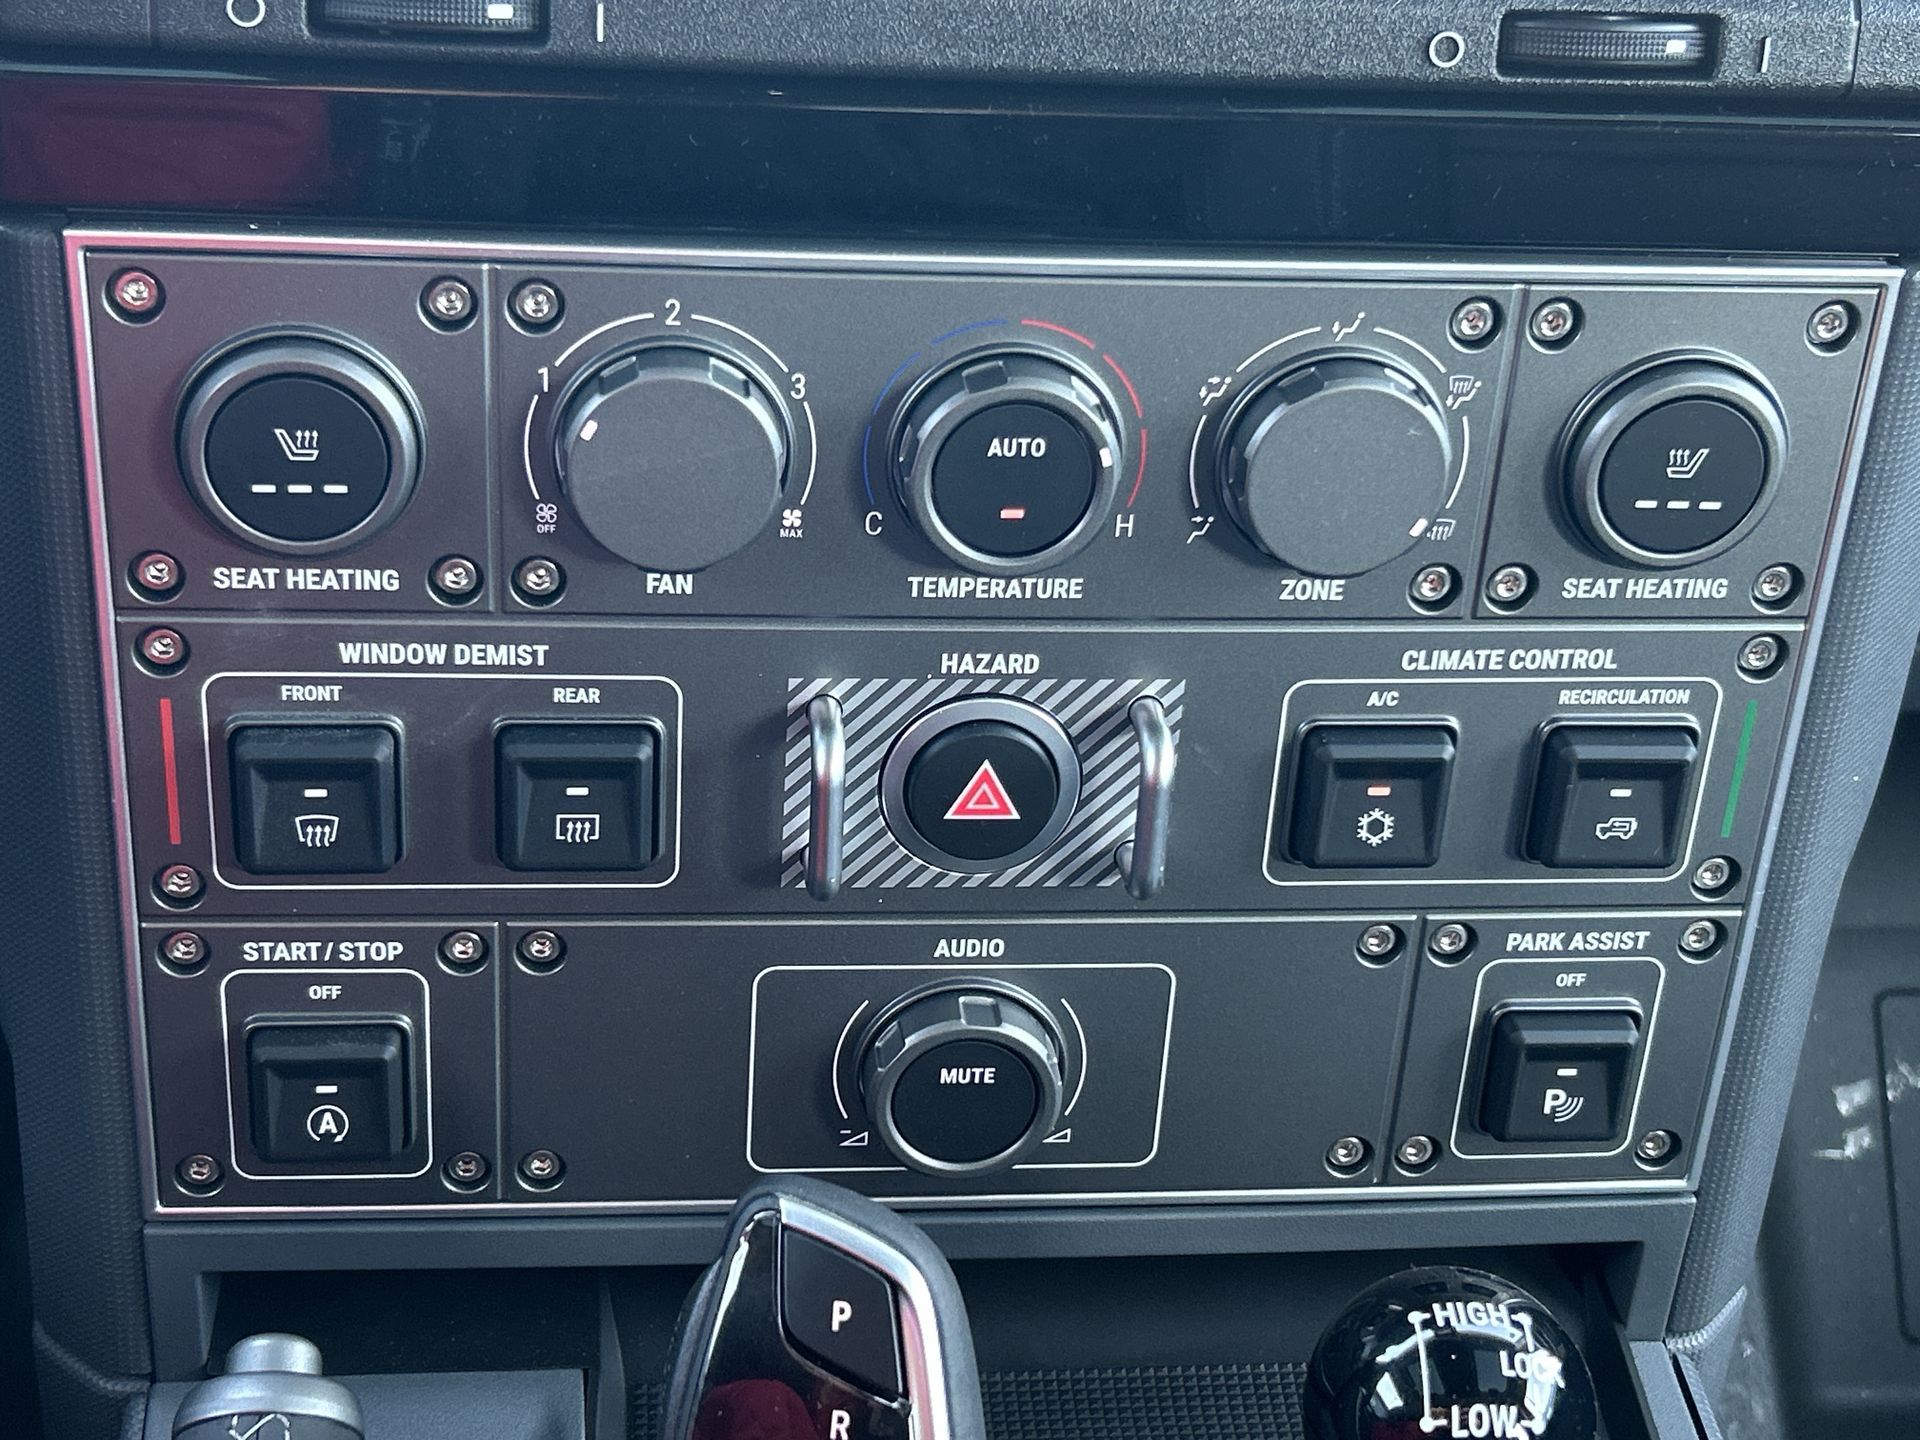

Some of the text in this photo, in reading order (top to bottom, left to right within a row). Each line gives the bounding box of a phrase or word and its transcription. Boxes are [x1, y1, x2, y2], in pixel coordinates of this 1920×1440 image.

[665, 299, 681, 325] 2
[538, 367, 548, 392] 1
[790, 375, 806, 399] 3
[988, 438, 1045, 457] AUTO
[537, 524, 556, 534] OFF
[780, 528, 803, 538] MAX
[866, 512, 882, 535] C
[1115, 514, 1134, 537] H
[213, 567, 399, 591] SEAT HEATING
[647, 573, 692, 594] FAN
[908, 577, 1083, 598] TEMPERATURE
[1279, 579, 1345, 600] ZONE
[1562, 578, 1728, 599] SEAT HEATING
[339, 643, 549, 665] WINDOW DEMIST
[941, 653, 1040, 674] HAZARD
[1402, 649, 1617, 670] CLIMATE CONTROL
[281, 685, 342, 701] FRONT
[554, 688, 600, 703] REAR
[1367, 691, 1399, 706] A/C
[1559, 689, 1690, 704] RECIRCULATION
[934, 939, 1004, 957] AUDIO
[1506, 931, 1650, 951] PARK ASSIST
[1556, 973, 1586, 987] OFF
[309, 986, 341, 999] OFF
[941, 1068, 995, 1083] MUTE
[832, 1301, 851, 1331] P
[1432, 1302, 1512, 1328] HIGH
[830, 1410, 850, 1440] R
[1451, 1404, 1519, 1438] LOW
